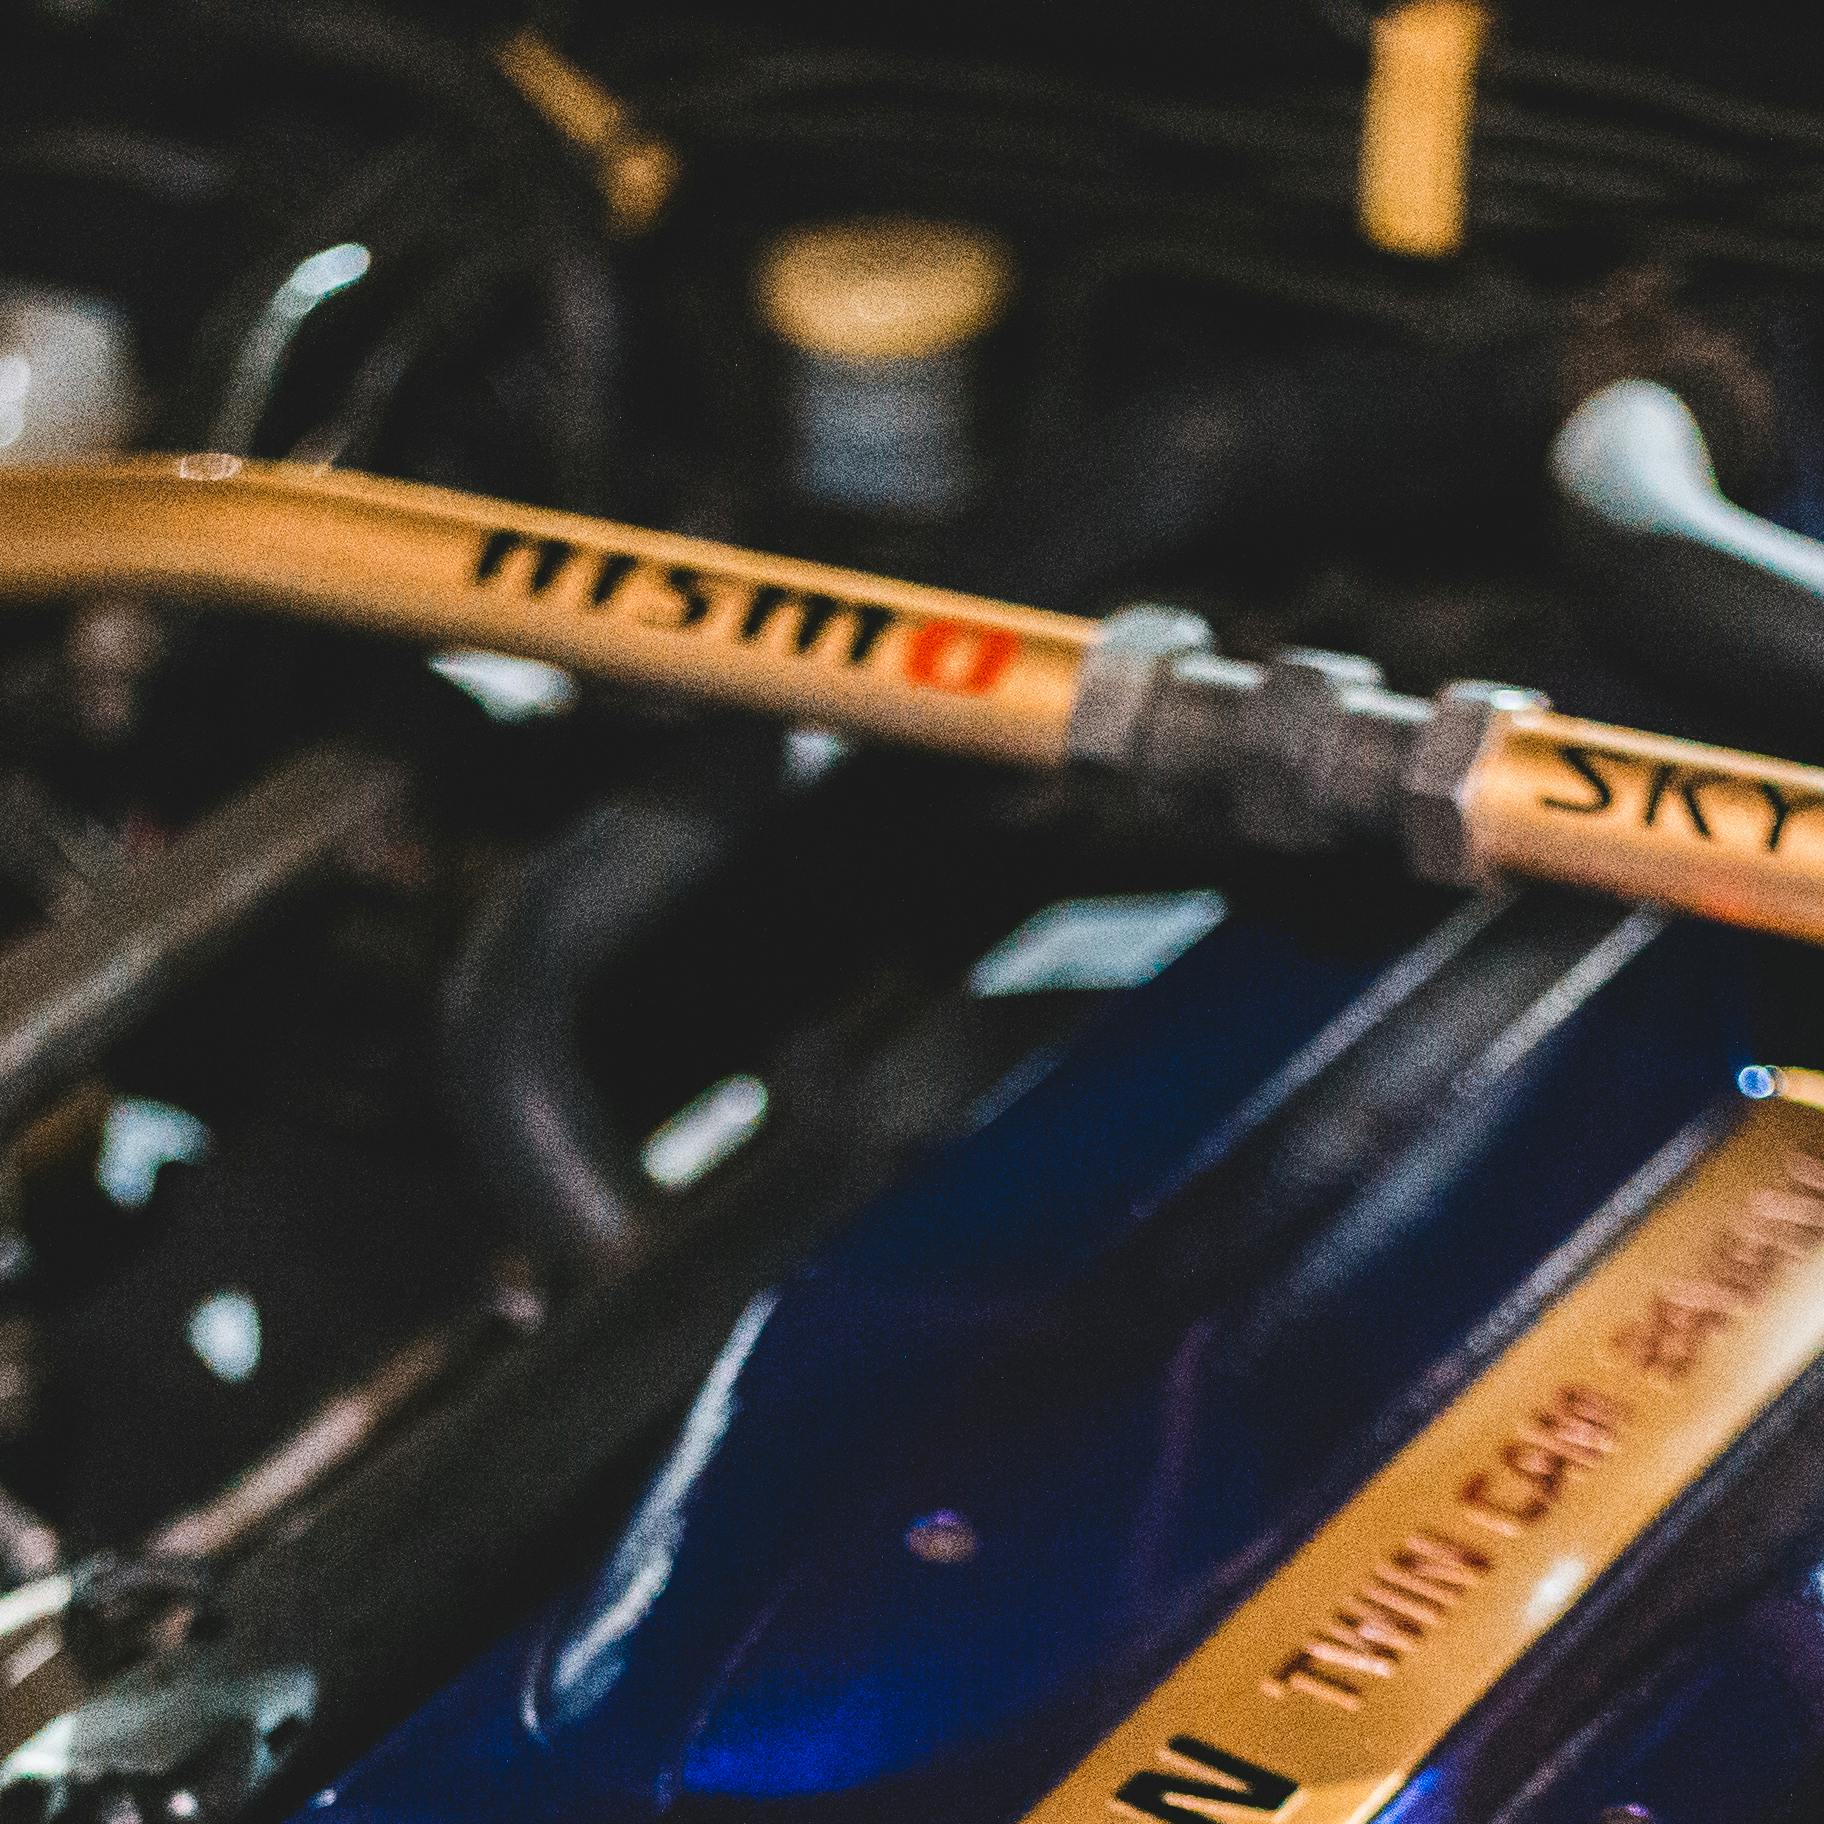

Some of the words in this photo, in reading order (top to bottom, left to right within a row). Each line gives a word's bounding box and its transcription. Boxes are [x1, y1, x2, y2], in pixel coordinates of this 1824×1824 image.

[476, 529, 1020, 698] nismo
[1259, 1526, 1492, 1712] TWIN
[1462, 1382, 1628, 1540] CAM
